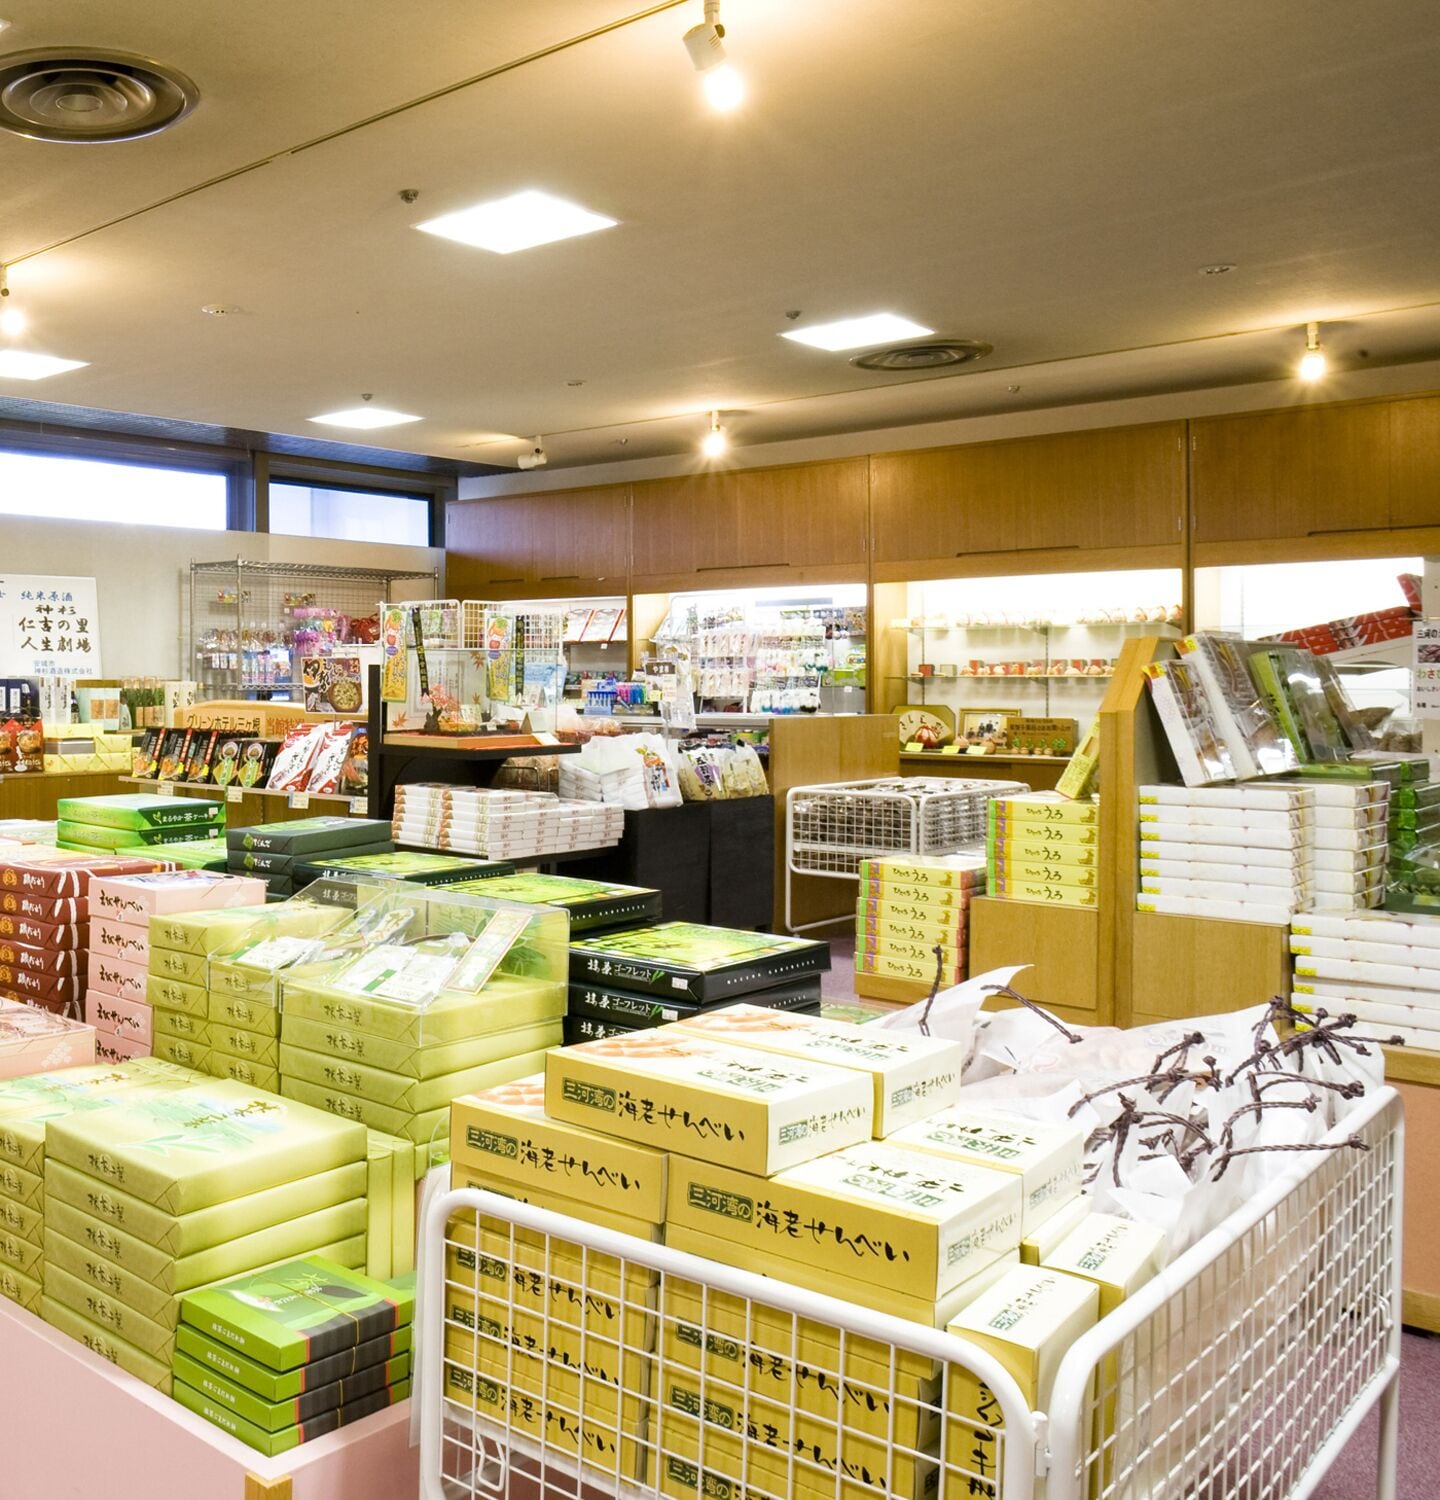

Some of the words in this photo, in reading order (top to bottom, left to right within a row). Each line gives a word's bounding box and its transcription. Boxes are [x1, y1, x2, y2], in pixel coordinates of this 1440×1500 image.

[21, 590, 73, 602] 純米原酒
[18, 616, 89, 633] 仁吉の里
[20, 637, 92, 653] 人生劇場
[563, 1079, 615, 1111] 三河湾の
[619, 1091, 744, 1141] 海老せんべい
[467, 1127, 517, 1159] 三河湾の
[520, 1139, 641, 1191] 海老せんべい
[689, 1184, 752, 1221] 三河湾の
[757, 1201, 910, 1261] 海老せんべい
